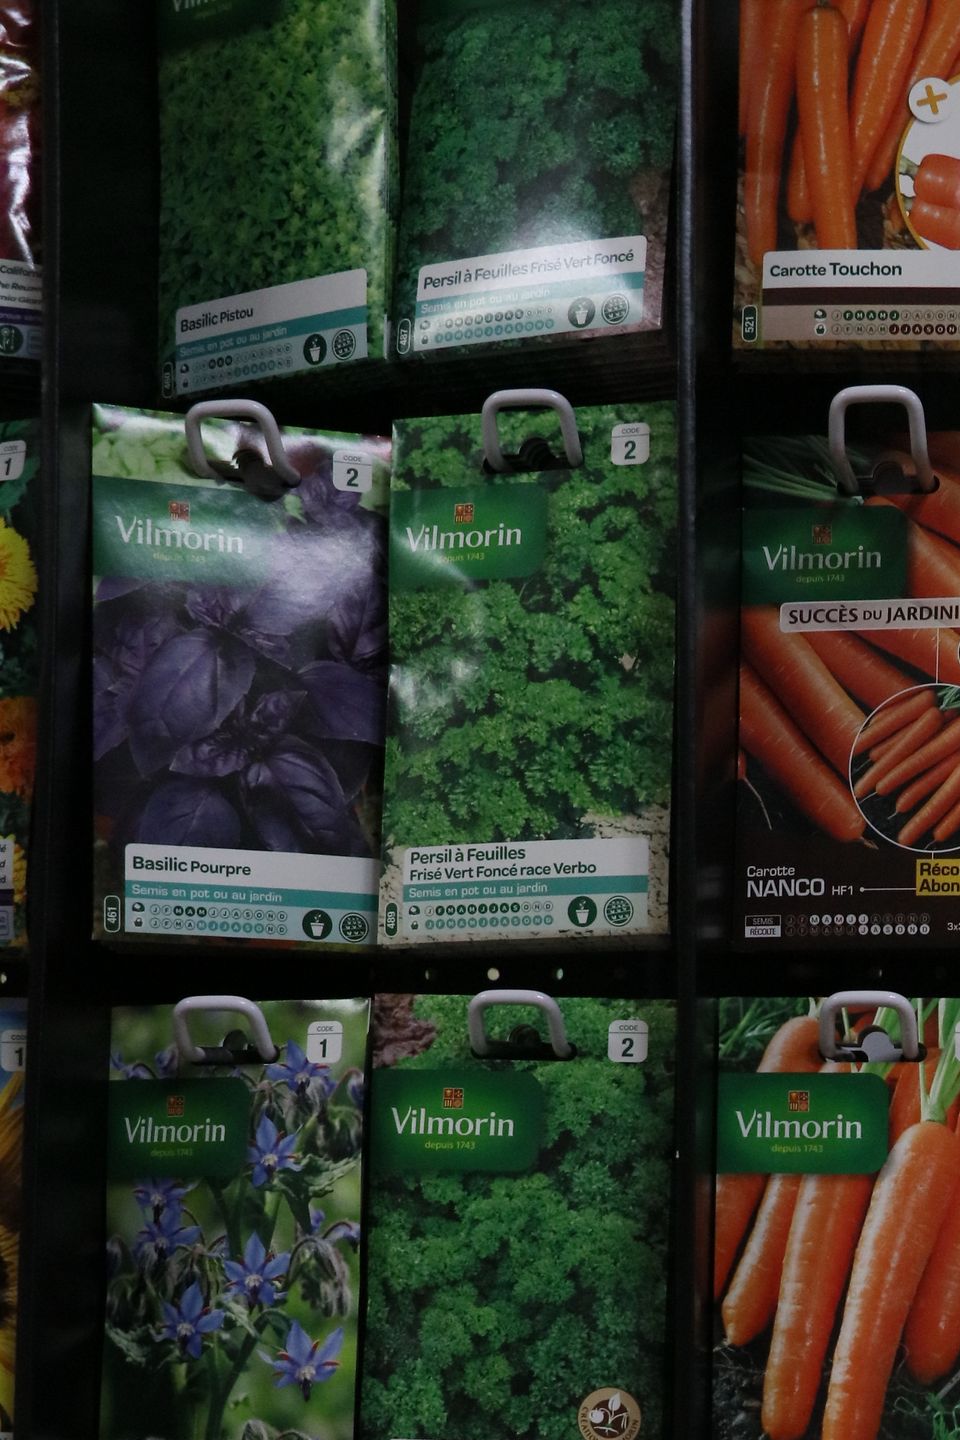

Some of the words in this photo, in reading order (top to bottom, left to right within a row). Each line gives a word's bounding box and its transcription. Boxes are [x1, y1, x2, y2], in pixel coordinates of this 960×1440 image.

[770, 264, 826, 277] Carotte
[830, 262, 902, 276] Touchon
[181, 315, 217, 332] Basilic
[220, 307, 253, 324] Pistou
[405, 523, 521, 552] Vilmorin
[763, 544, 881, 571] Vilmorin
[789, 605, 858, 624] SUCCÈS
[863, 609, 882, 620] DU
[411, 850, 452, 864] Persil
[455, 849, 463, 861] à
[467, 846, 526, 861] Feuilles
[133, 856, 188, 871] Basilic
[191, 861, 251, 876] Pourpre
[410, 868, 442, 881] Frisé
[445, 867, 473, 879] Vert
[477, 864, 517, 878] Foncé
[520, 865, 550, 875] race
[554, 862, 596, 874] Verbo
[747, 866, 795, 877] Carotte
[747, 878, 825, 898] NANCO
[832, 886, 854, 895] HF1
[124, 1116, 225, 1143] Vilmorin
[391, 1105, 514, 1137] Vilmorin
[736, 1109, 862, 1139] Vilmorin
